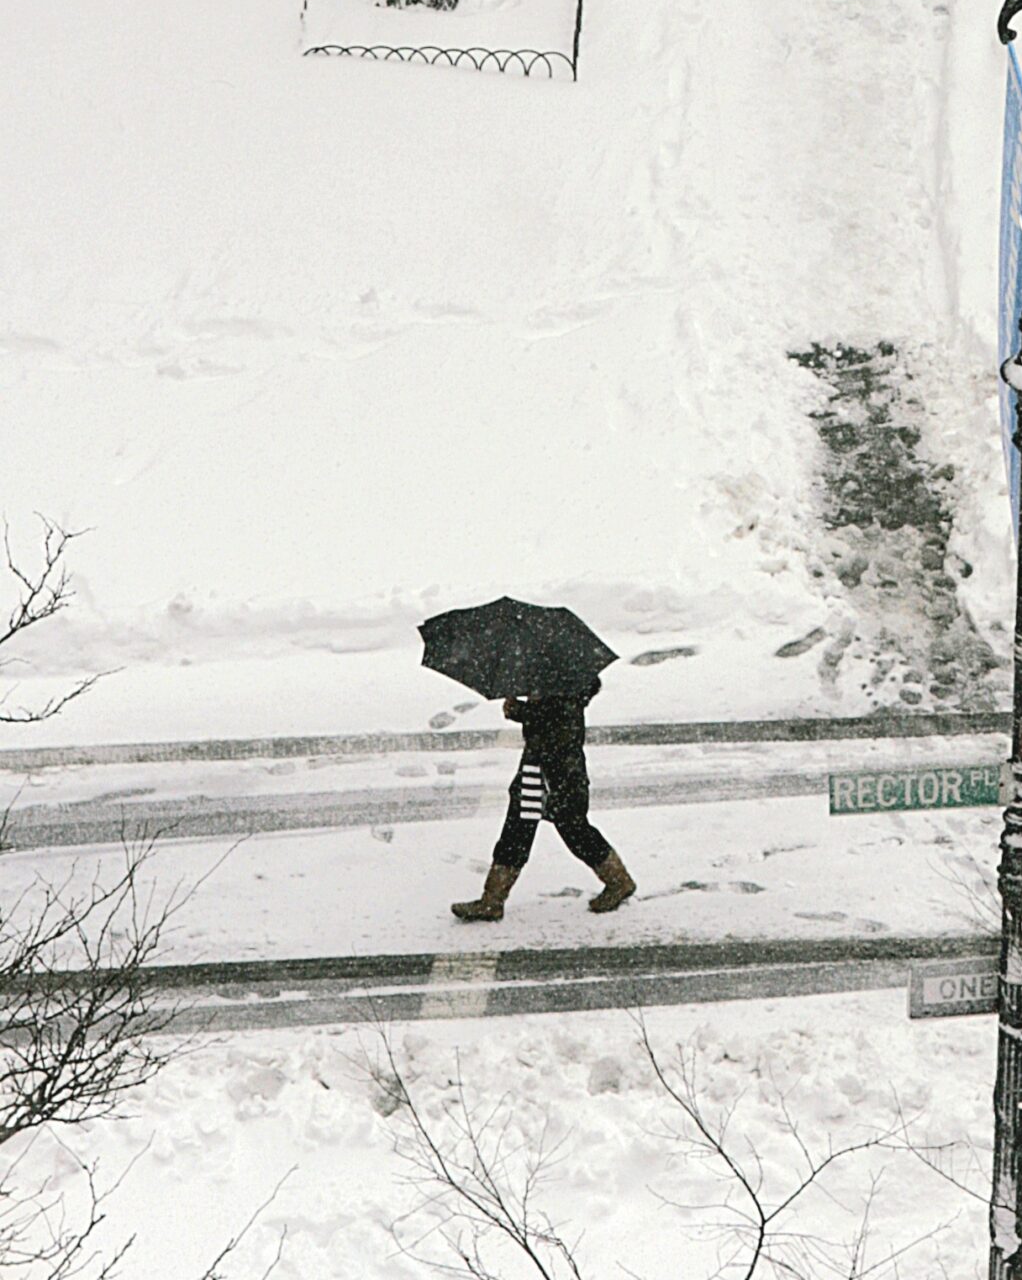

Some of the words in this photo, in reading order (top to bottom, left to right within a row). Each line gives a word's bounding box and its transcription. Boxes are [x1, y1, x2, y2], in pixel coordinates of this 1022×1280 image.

[833, 771, 963, 810] RECTOR
[970, 769, 996, 786] PL
[939, 976, 994, 1000] ONE
